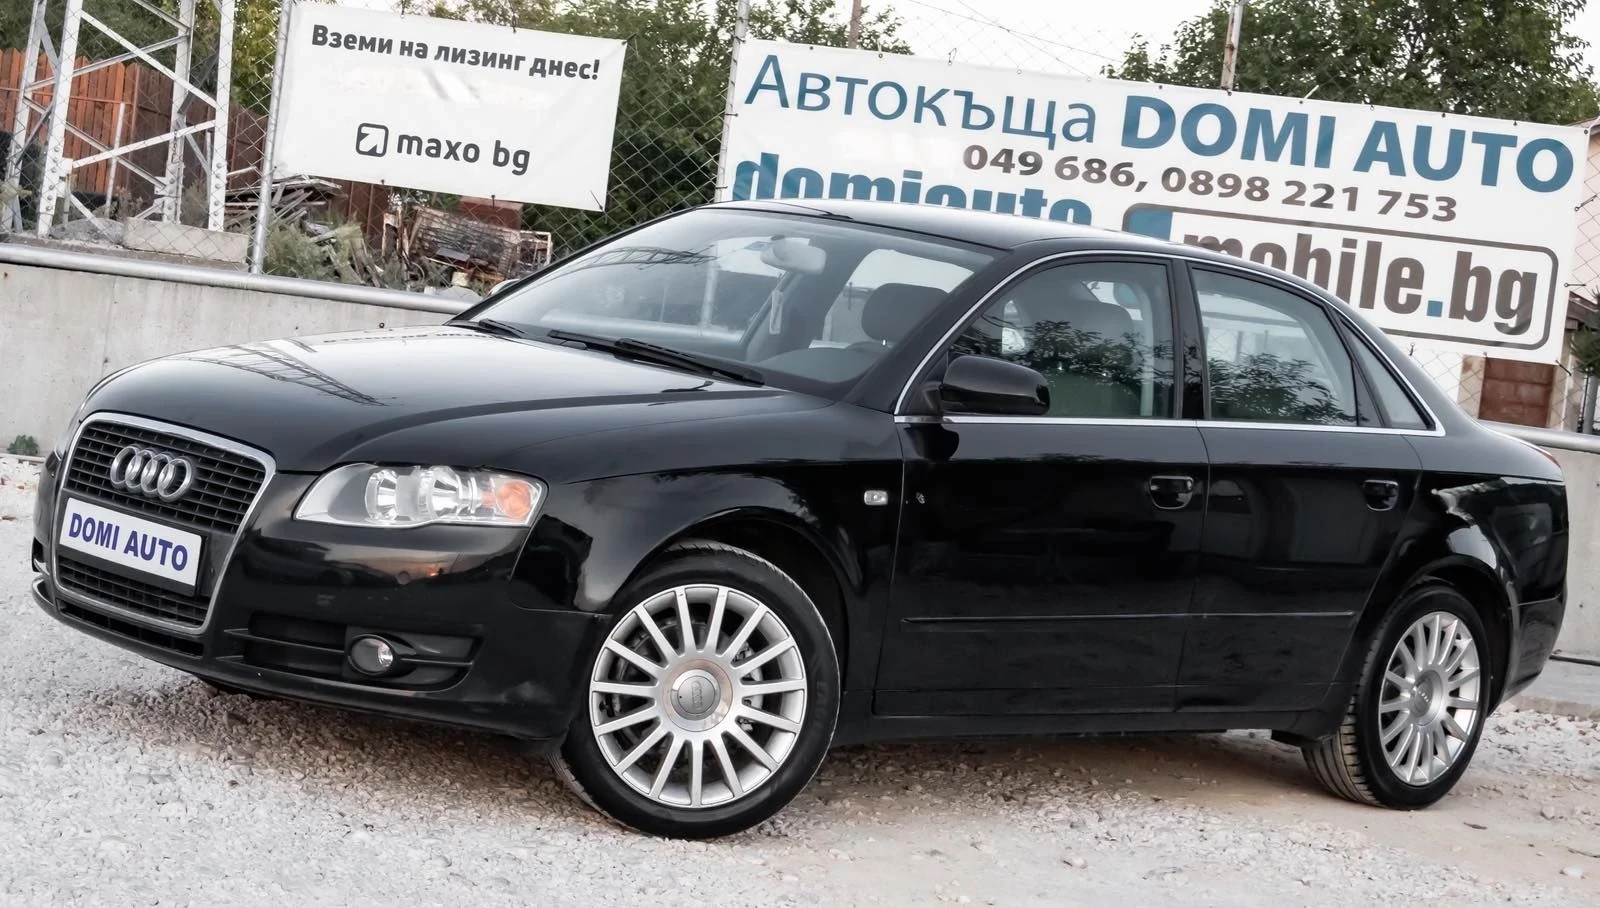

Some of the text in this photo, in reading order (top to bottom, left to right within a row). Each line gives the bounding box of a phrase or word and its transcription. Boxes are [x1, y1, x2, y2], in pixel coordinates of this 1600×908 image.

[312, 24, 600, 80] Вземи на лизинг днес!
[744, 54, 1574, 193] Автокъща DOMI AUTO
[397, 133, 531, 176] maxo bg
[963, 144, 1457, 222] 049 686, 0898 221 753
[68, 512, 188, 571] DOMI AUTO
